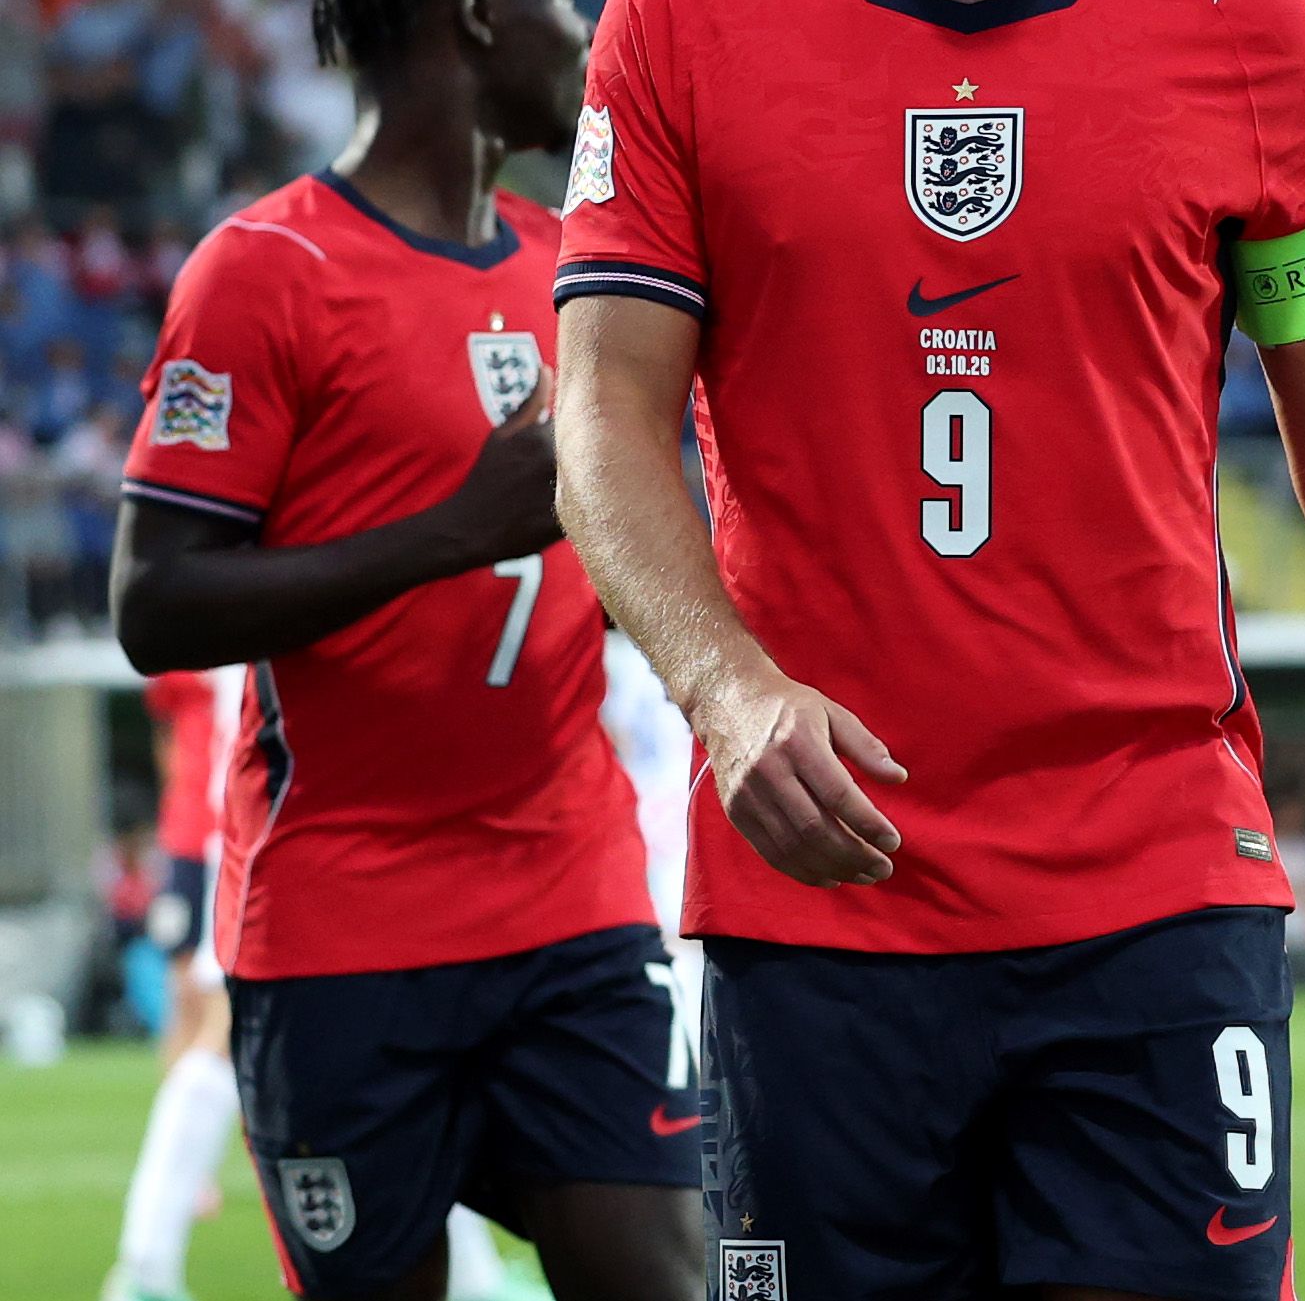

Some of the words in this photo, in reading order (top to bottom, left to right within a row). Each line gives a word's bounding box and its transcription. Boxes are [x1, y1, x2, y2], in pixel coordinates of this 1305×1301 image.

[920, 328, 996, 350] CROATIA
[926, 354, 990, 376] 03.10.26
[922, 390, 991, 557] 9
[486, 553, 543, 687] 7
[1212, 1026, 1273, 1191] 9
